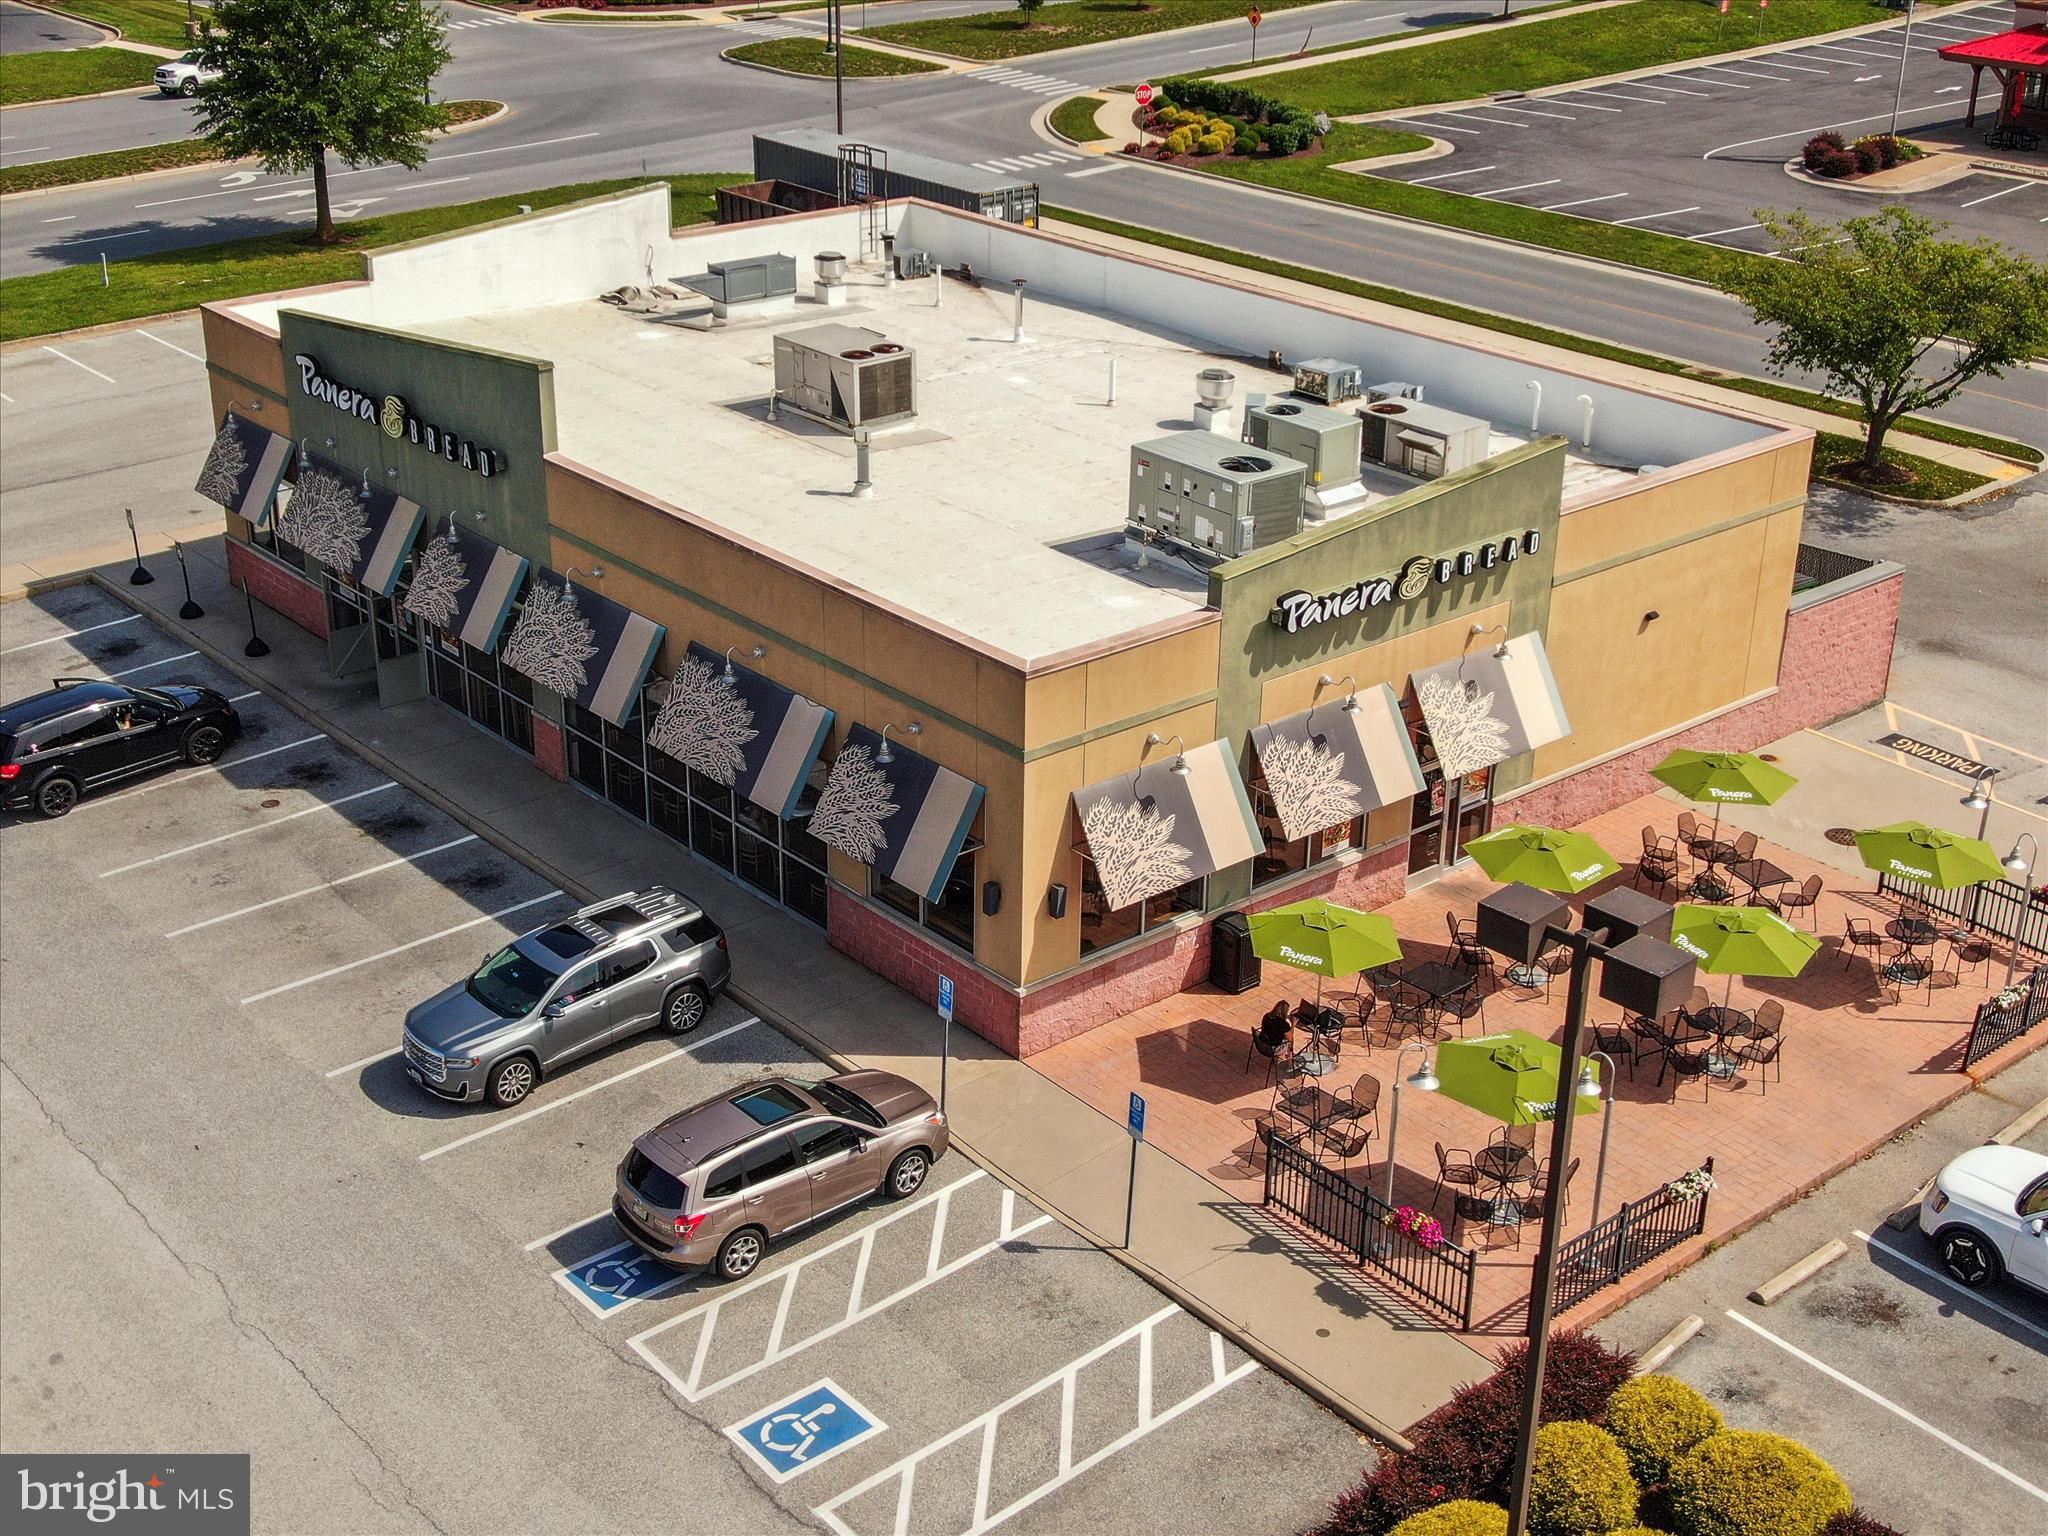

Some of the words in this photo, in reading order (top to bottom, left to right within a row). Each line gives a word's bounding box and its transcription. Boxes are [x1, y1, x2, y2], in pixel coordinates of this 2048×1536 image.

[1136, 90, 1152, 100] STOP
[295, 354, 377, 426] Panera
[409, 417, 490, 478] BREAD
[1282, 578, 1392, 634] Panera
[1440, 531, 1541, 584] BREAD
[1892, 738, 1981, 774] PARKING
[1708, 787, 1753, 799] Panera
[1890, 859, 1933, 879] Panera
[1280, 945, 1323, 966] Panera
